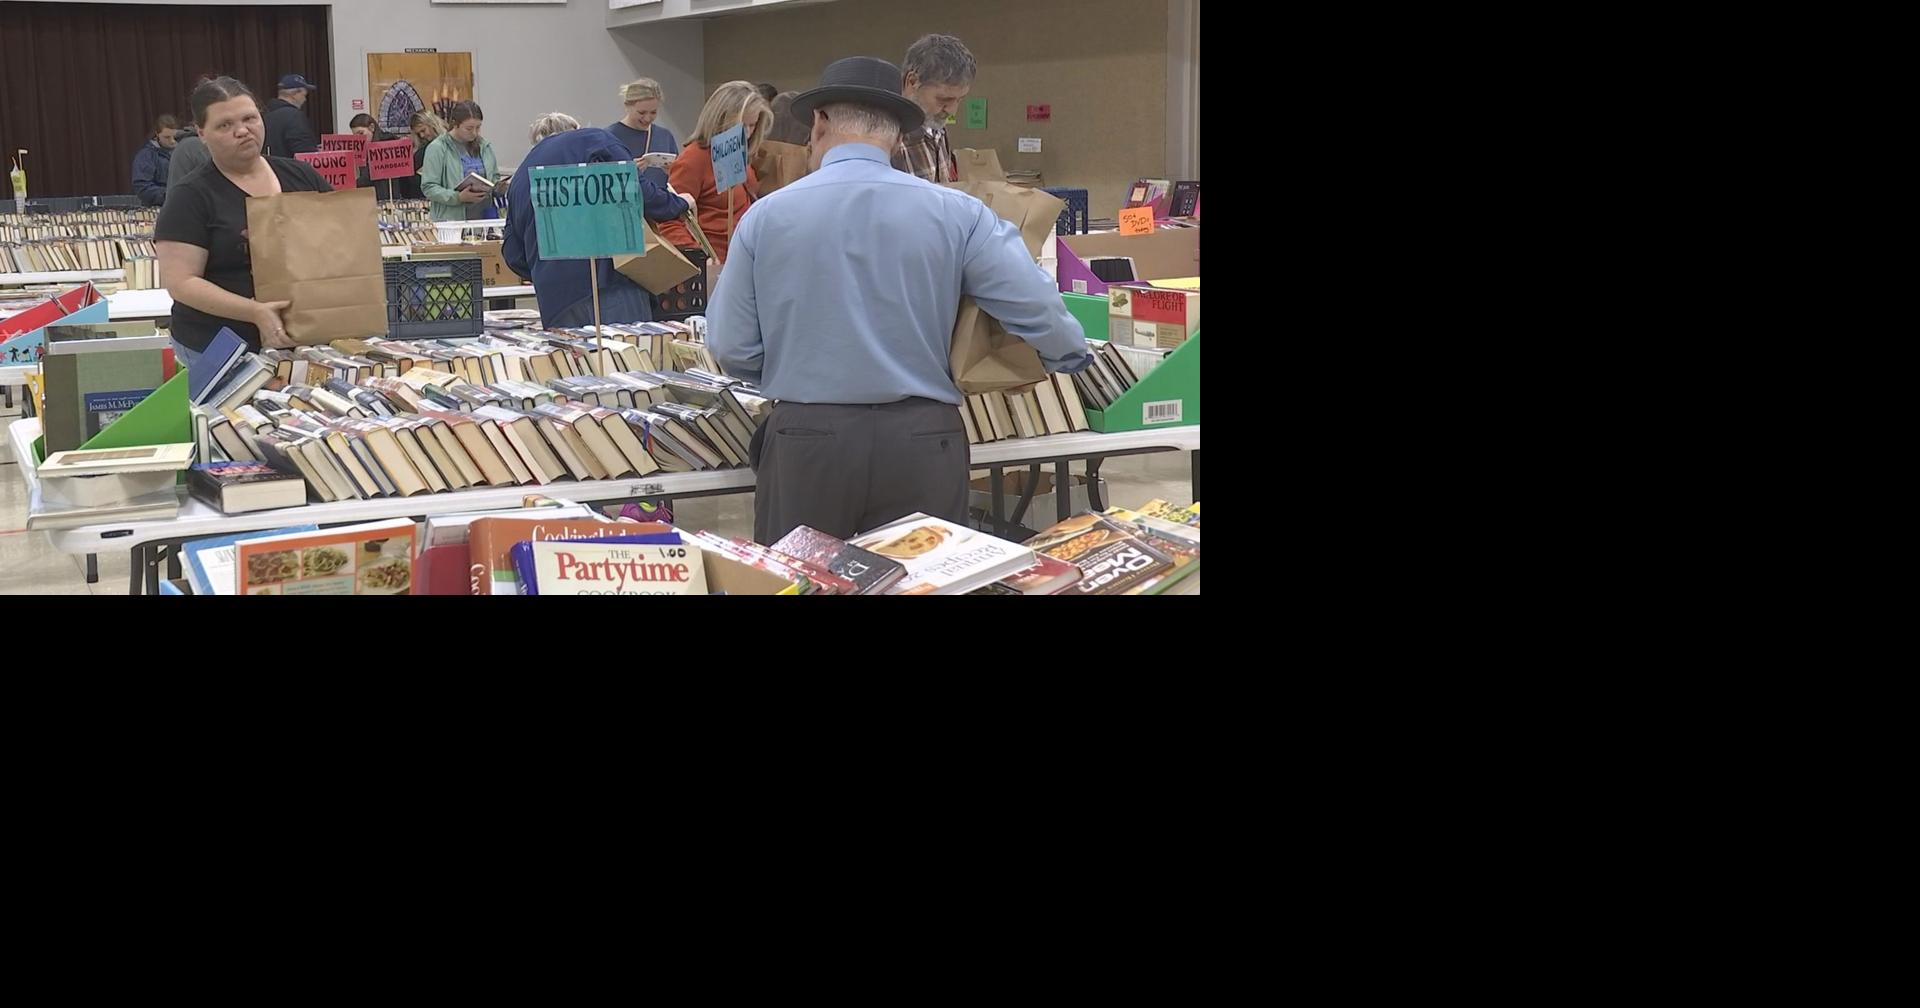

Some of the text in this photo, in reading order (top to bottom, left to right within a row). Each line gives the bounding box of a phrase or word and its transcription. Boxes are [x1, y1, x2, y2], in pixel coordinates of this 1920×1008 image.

[323, 140, 366, 151] MYSTERY
[369, 145, 412, 161] MYSTERY
[324, 173, 347, 185] ULT
[534, 172, 631, 208] HISTORY
[1152, 299, 1184, 312] FLIGHT
[608, 549, 631, 559] THE
[554, 552, 690, 592] Partytime
[1079, 546, 1143, 583] Mea
[1078, 554, 1153, 593] Oven
